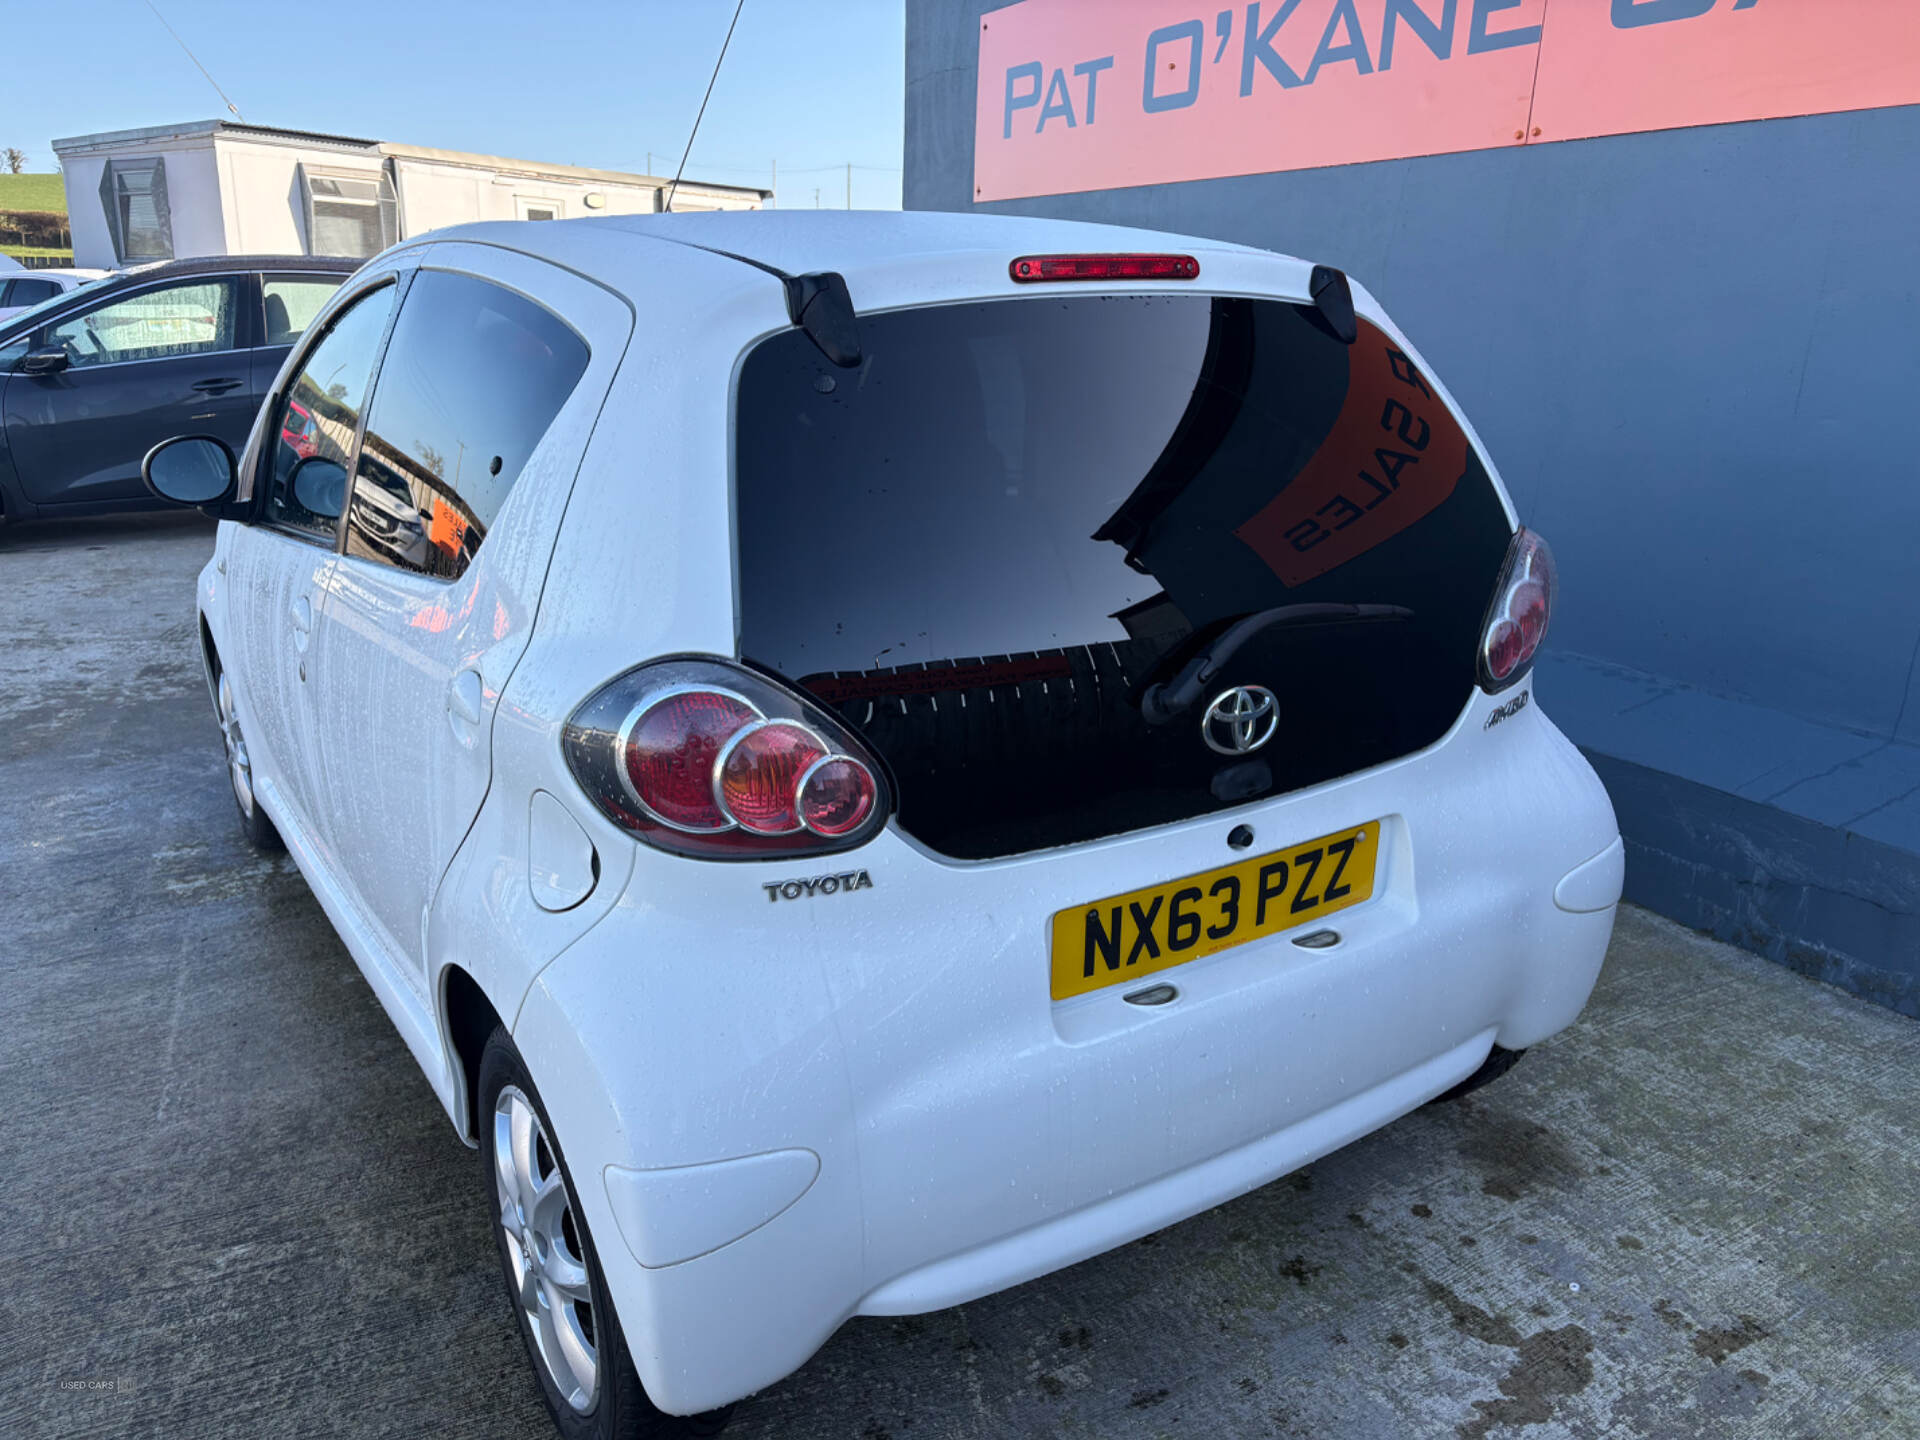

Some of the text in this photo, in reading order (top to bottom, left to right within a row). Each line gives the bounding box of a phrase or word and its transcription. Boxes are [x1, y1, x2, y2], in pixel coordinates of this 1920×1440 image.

[1003, 0, 1542, 139] PAT O'KANE
[762, 868, 874, 902] TOYOTA
[1083, 838, 1355, 978] NX63 PZZ
